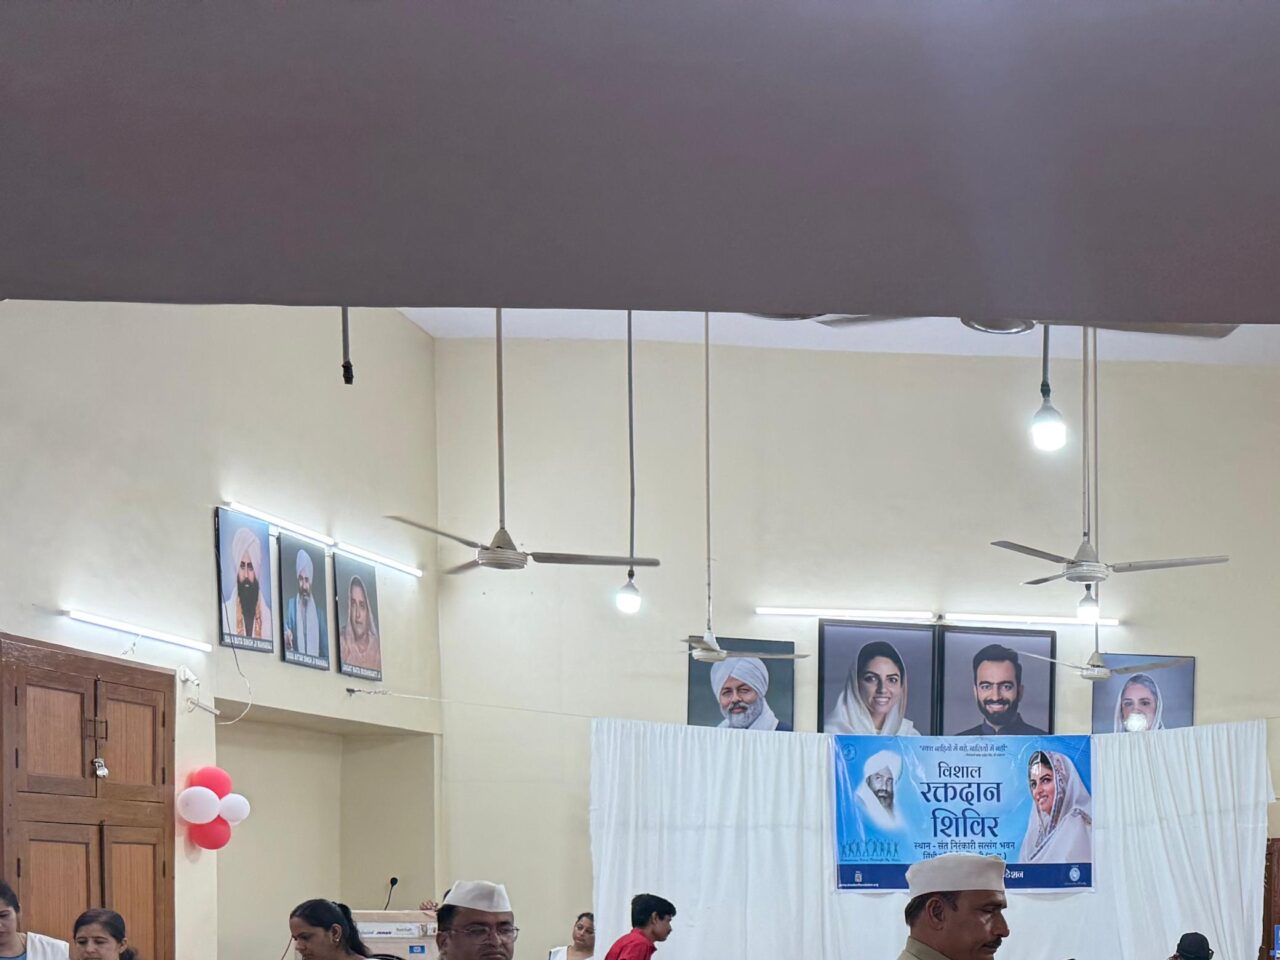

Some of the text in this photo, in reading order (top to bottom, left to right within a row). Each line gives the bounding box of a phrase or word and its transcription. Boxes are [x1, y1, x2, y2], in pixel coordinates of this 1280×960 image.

[938, 761, 981, 779] विशाल
[920, 782, 1002, 803] रक्तदान
[931, 808, 999, 838] शिविर
[914, 841, 931, 849] स्थान
[937, 840, 949, 849] संत
[951, 840, 975, 849] निरंकारी
[978, 840, 997, 849] सत्संग
